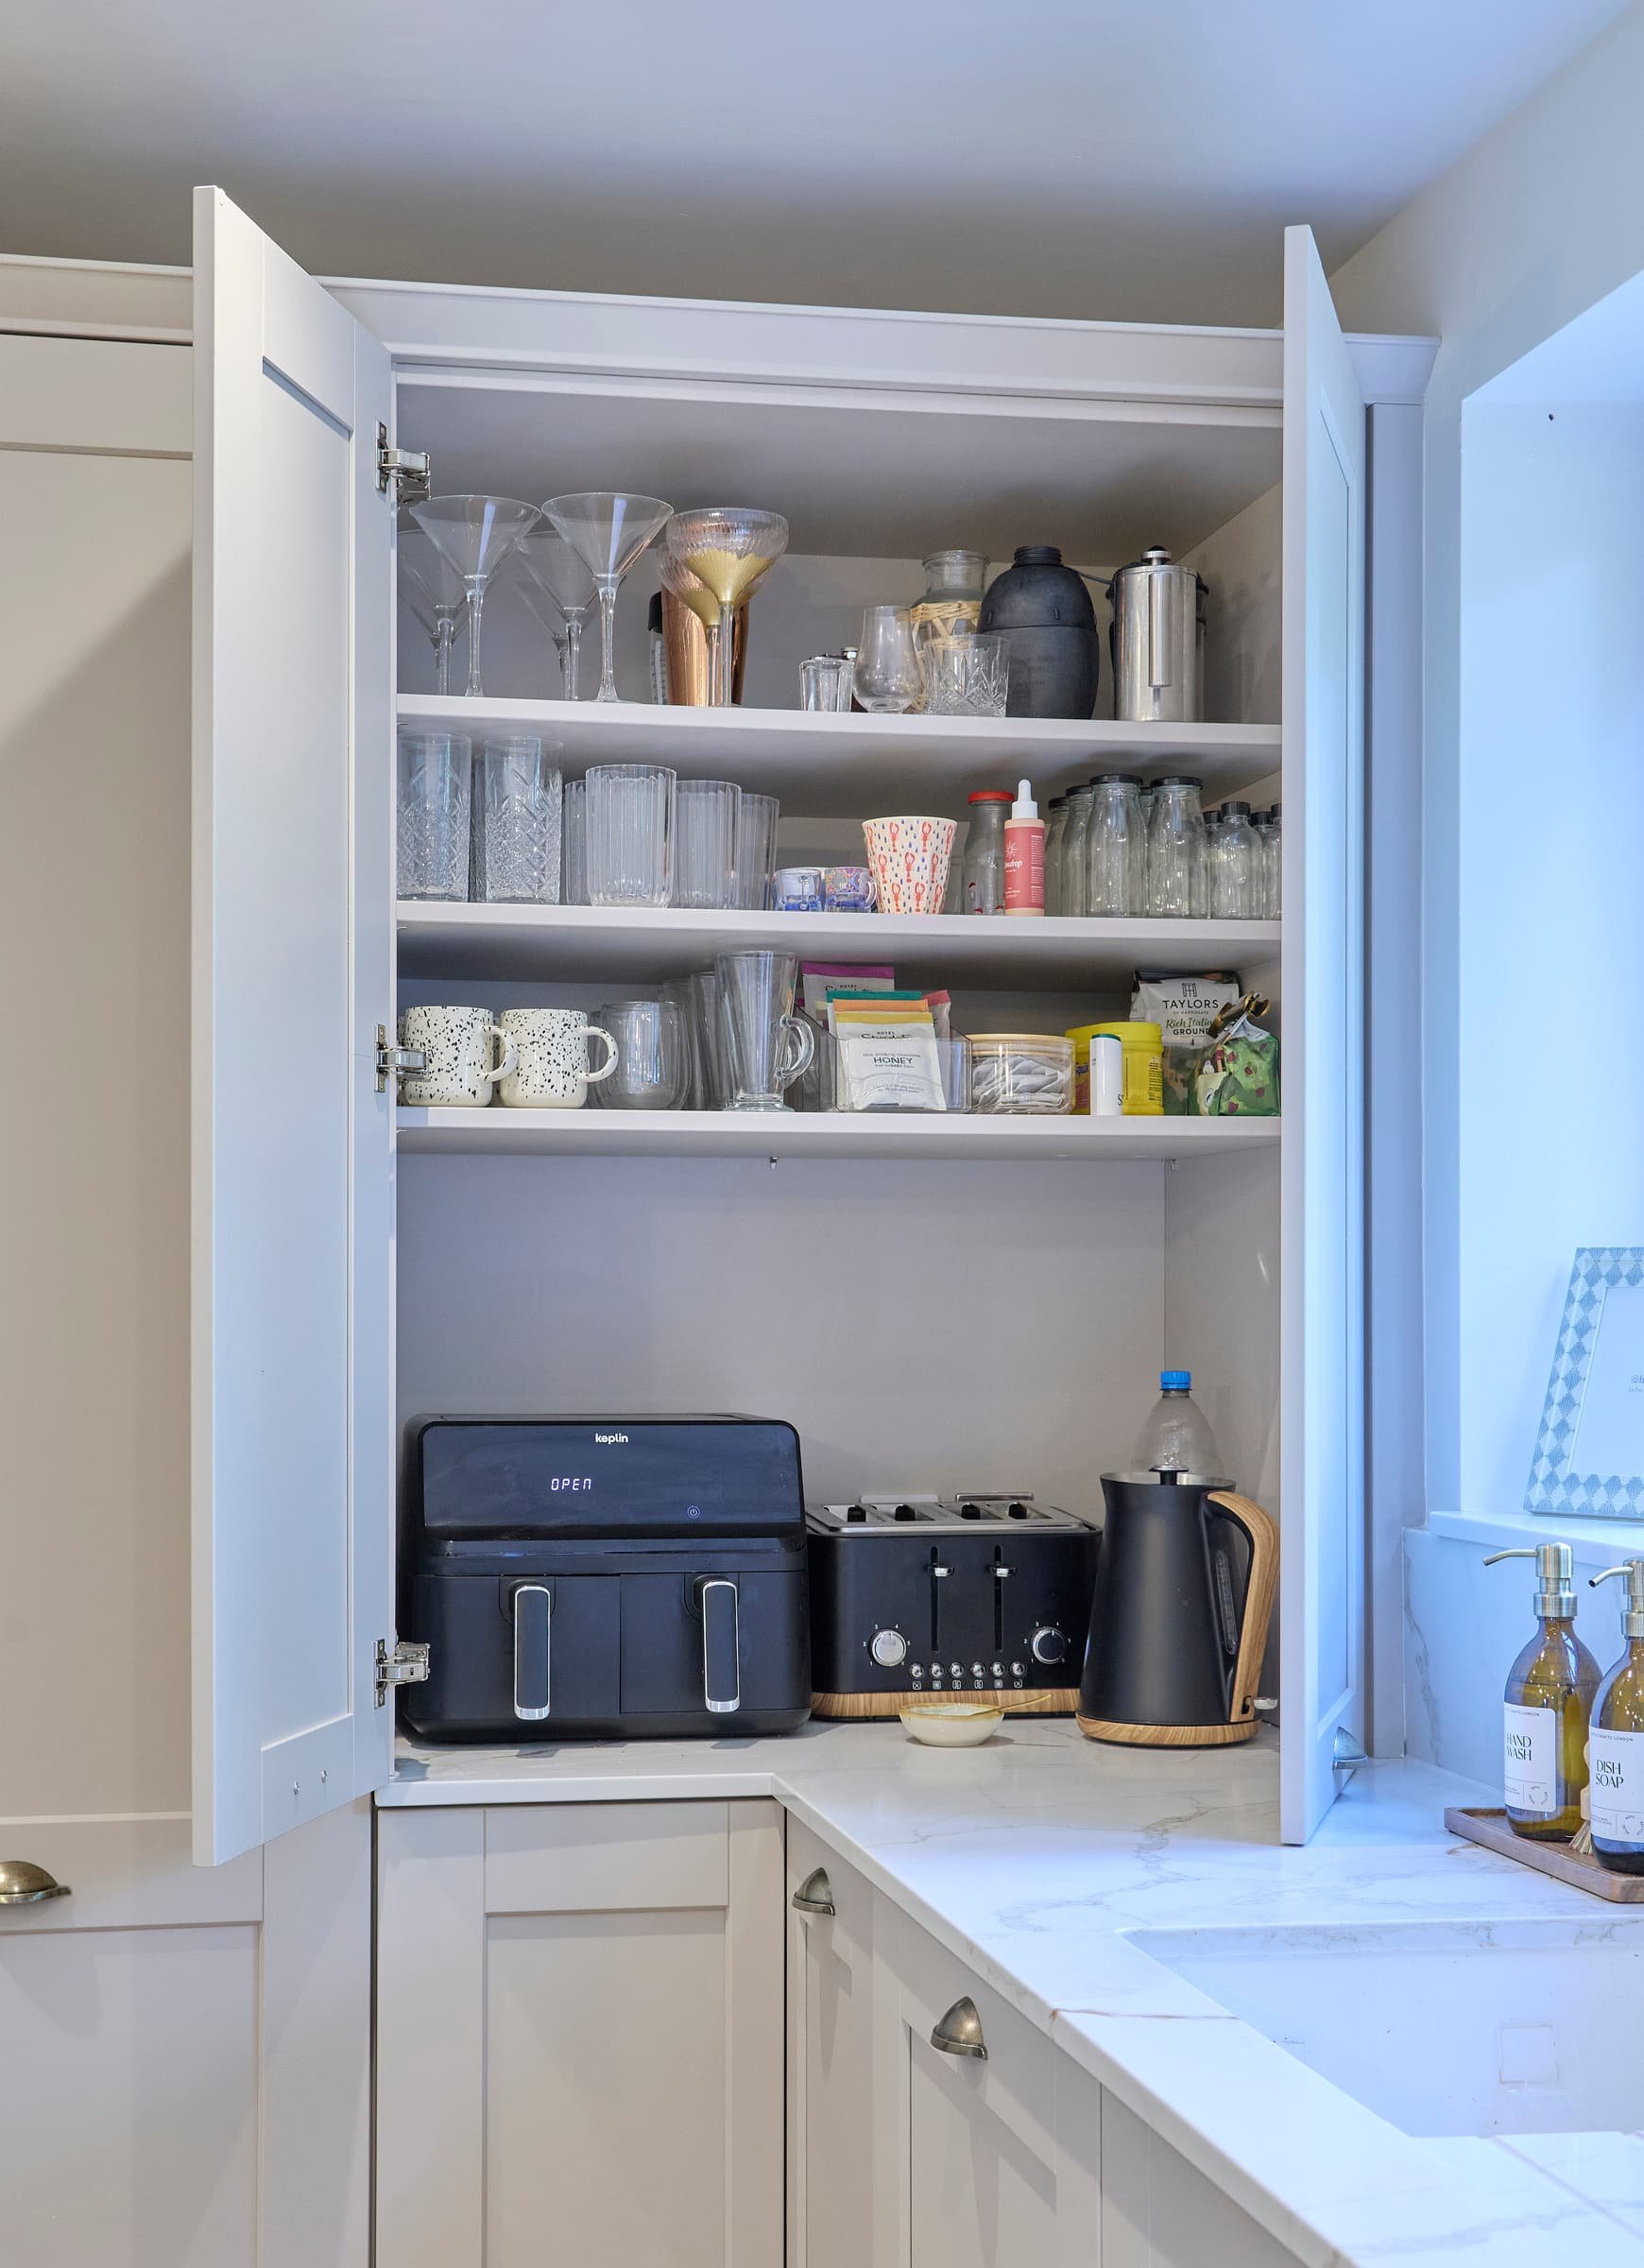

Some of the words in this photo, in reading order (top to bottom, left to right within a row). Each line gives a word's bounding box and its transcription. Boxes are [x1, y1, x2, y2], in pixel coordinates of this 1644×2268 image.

[1162, 999, 1219, 1009] TAYLORS
[1165, 1018, 1187, 1029] Rich
[595, 1433, 629, 1445] keplin
[1507, 1732, 1532, 1748] HAND
[1506, 1745, 1532, 1761] WASH
[1596, 1759, 1621, 1775] DISH
[1595, 1773, 1624, 1789] SOAP
